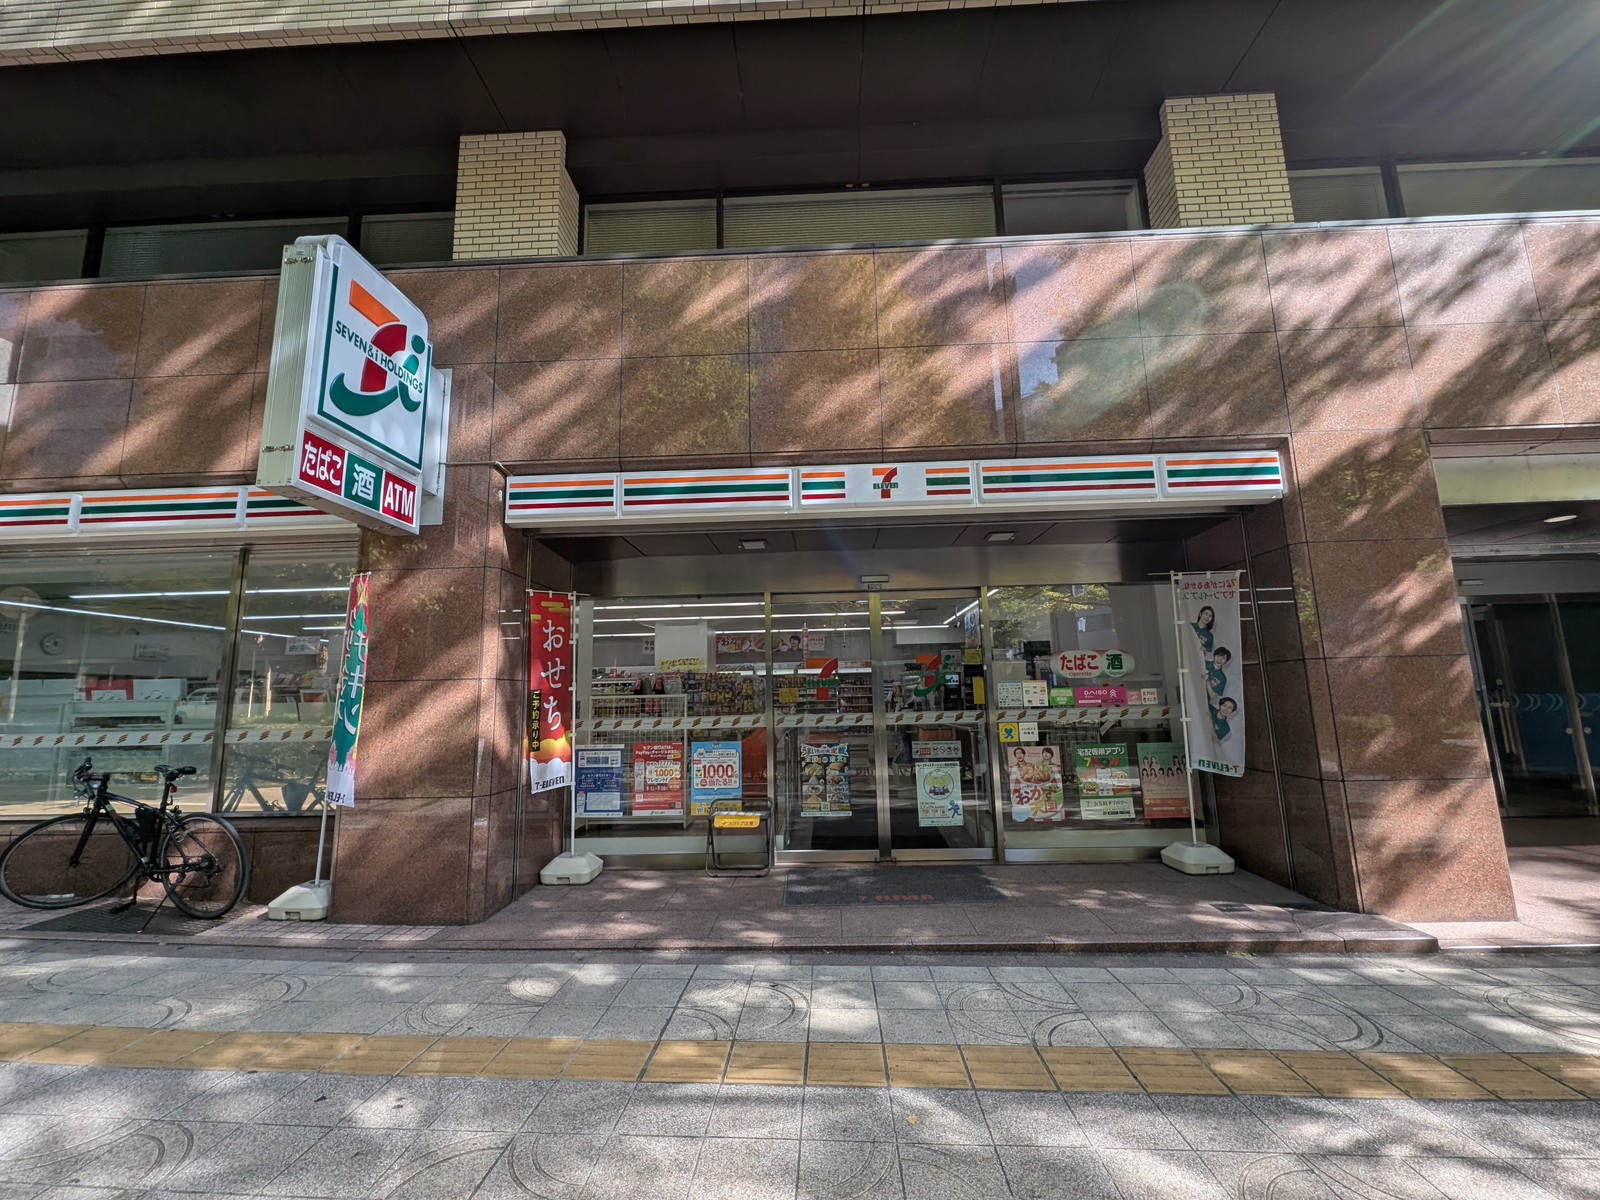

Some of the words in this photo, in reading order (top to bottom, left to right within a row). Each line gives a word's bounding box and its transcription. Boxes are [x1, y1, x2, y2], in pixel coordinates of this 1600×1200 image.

[379, 353, 424, 394] HOLDINGS
[302, 441, 343, 487] たばこ
[352, 463, 376, 500] 酒
[383, 480, 415, 518] ATM
[541, 619, 566, 731] おせち
[1060, 653, 1099, 671] たばこ
[1105, 653, 1123, 670] 酒
[531, 689, 541, 750] ご予約承り中
